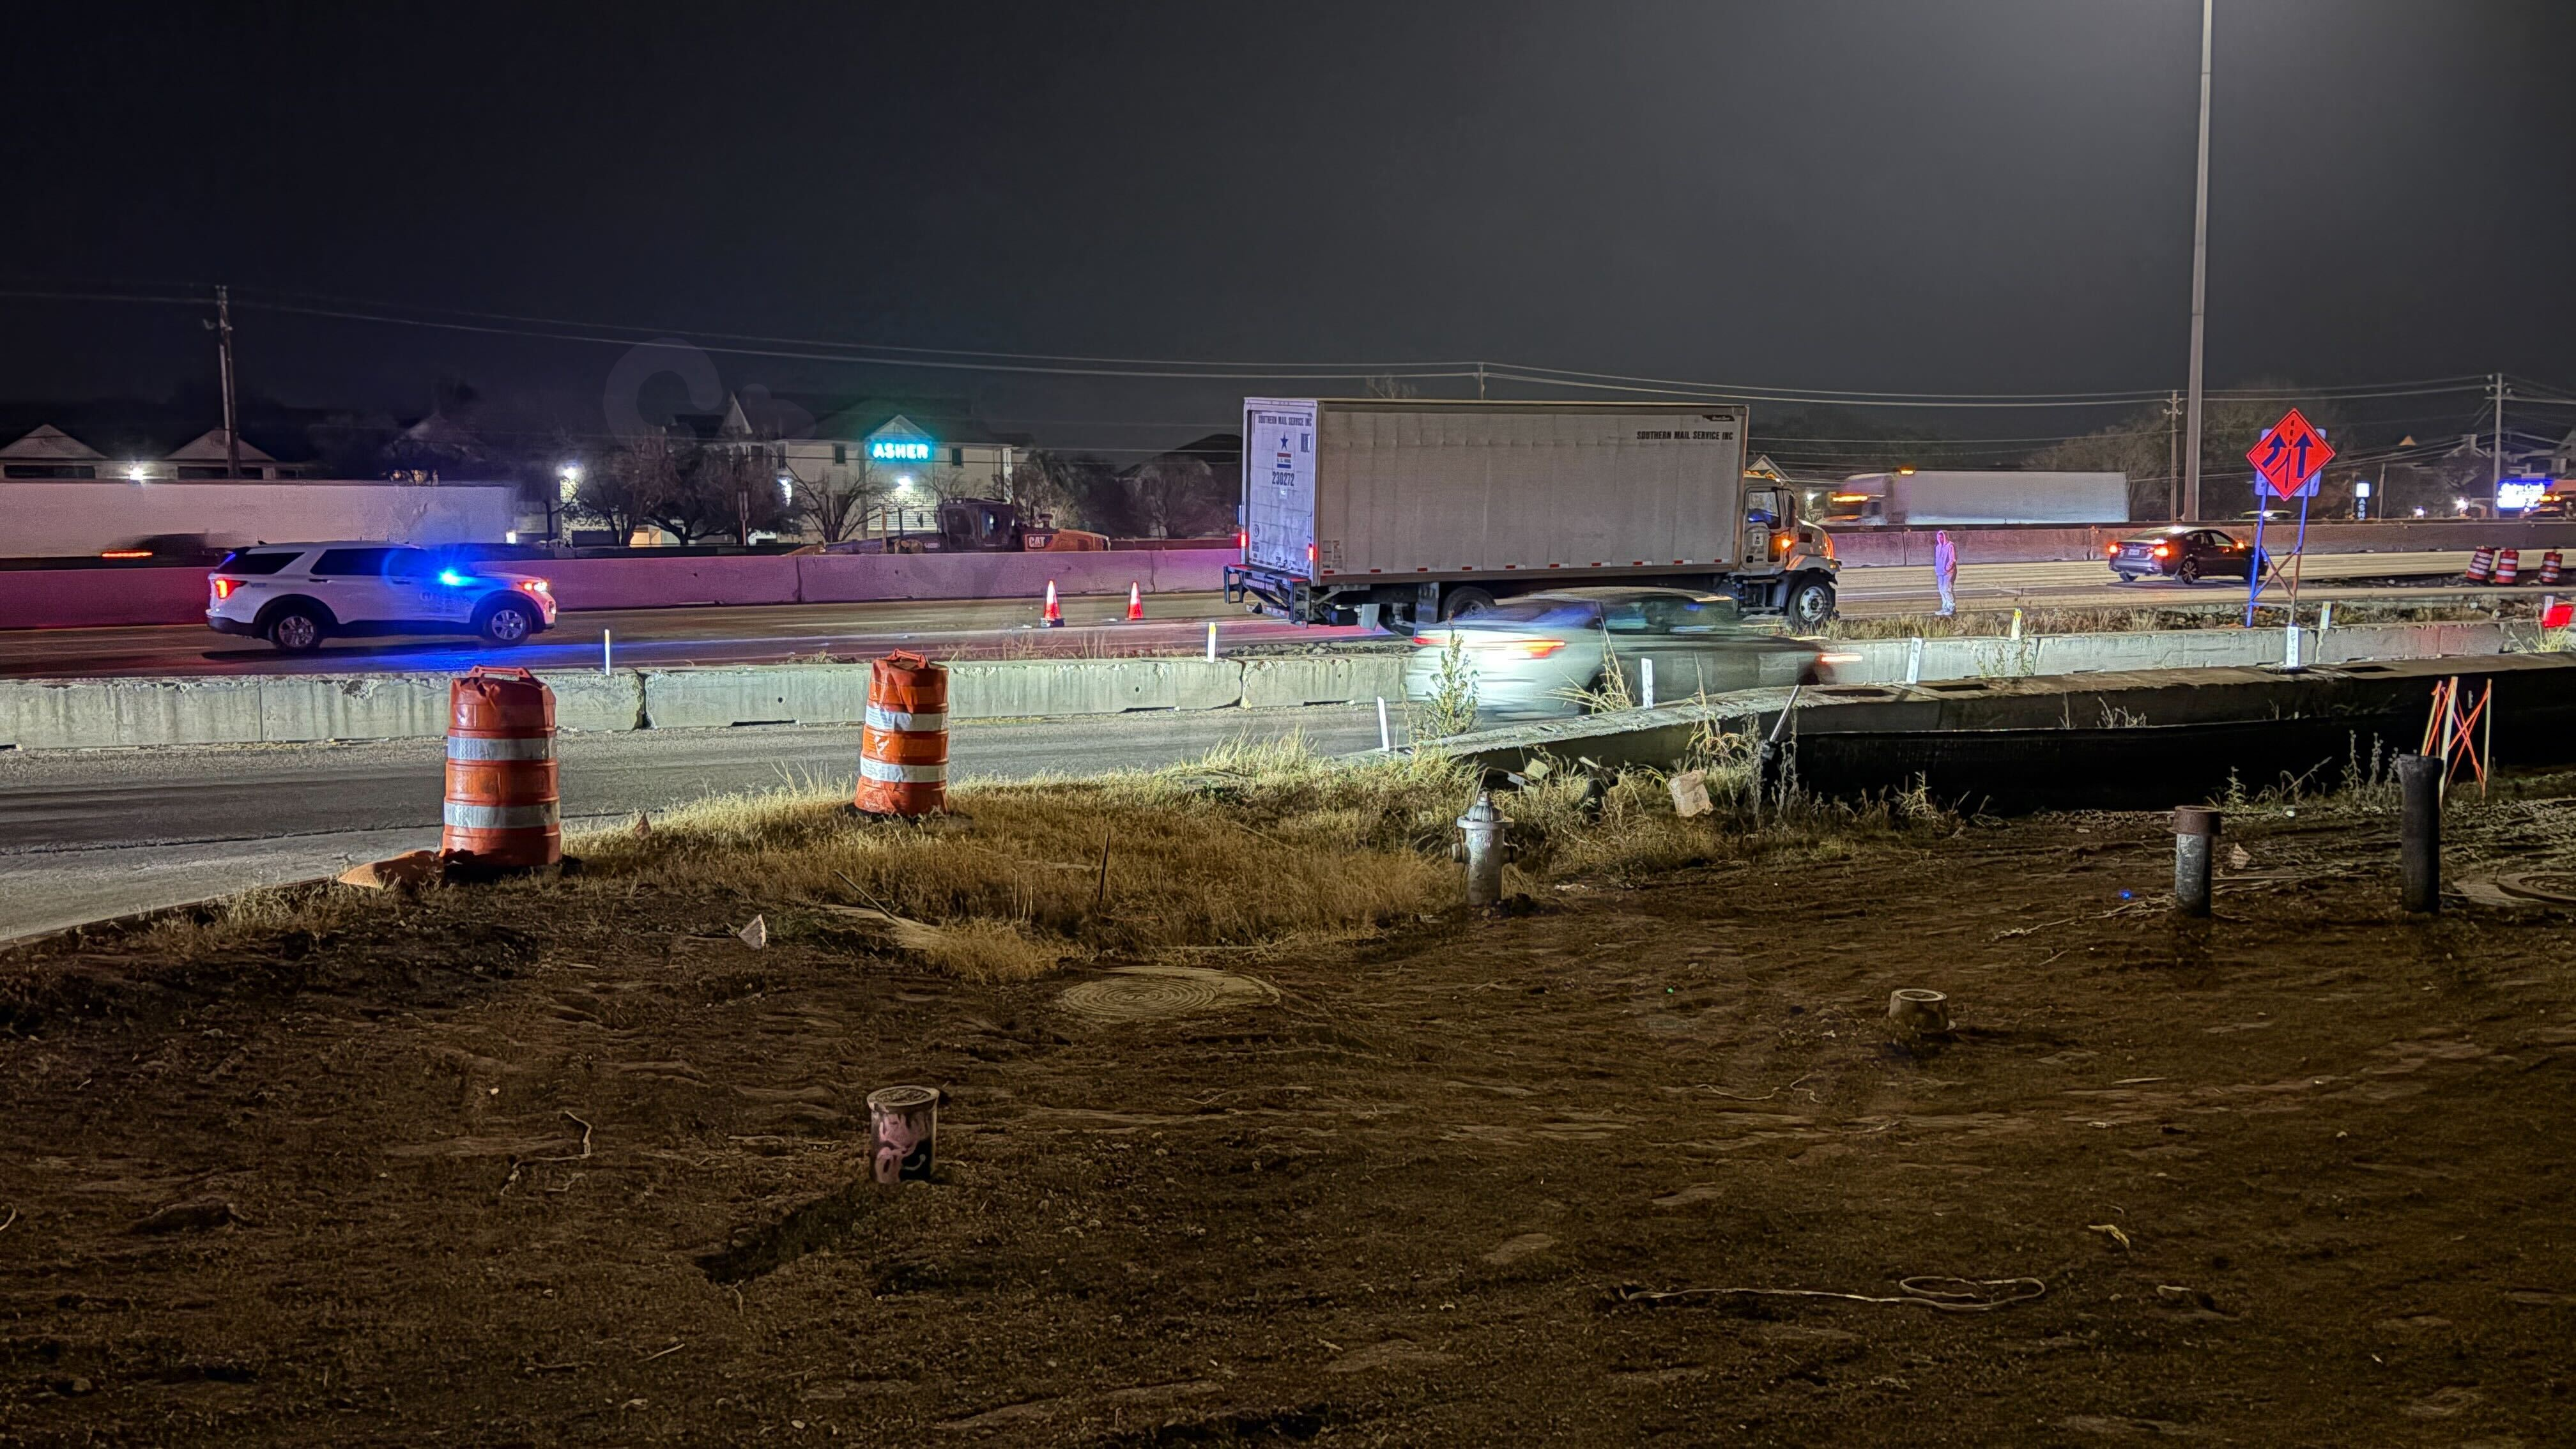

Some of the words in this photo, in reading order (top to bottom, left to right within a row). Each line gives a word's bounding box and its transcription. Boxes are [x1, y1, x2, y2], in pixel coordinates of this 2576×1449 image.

[1278, 417, 1287, 425] MAIL
[1289, 417, 1304, 426] SERVICE
[1637, 431, 1671, 440] SOUTHERN
[1674, 431, 1690, 440] MAIL
[1693, 431, 1720, 440] SERVICE
[1722, 432, 1733, 440] INC
[873, 443, 928, 459] ASHER
[1272, 471, 1294, 486] 230272
[1029, 537, 1045, 547] CAT
